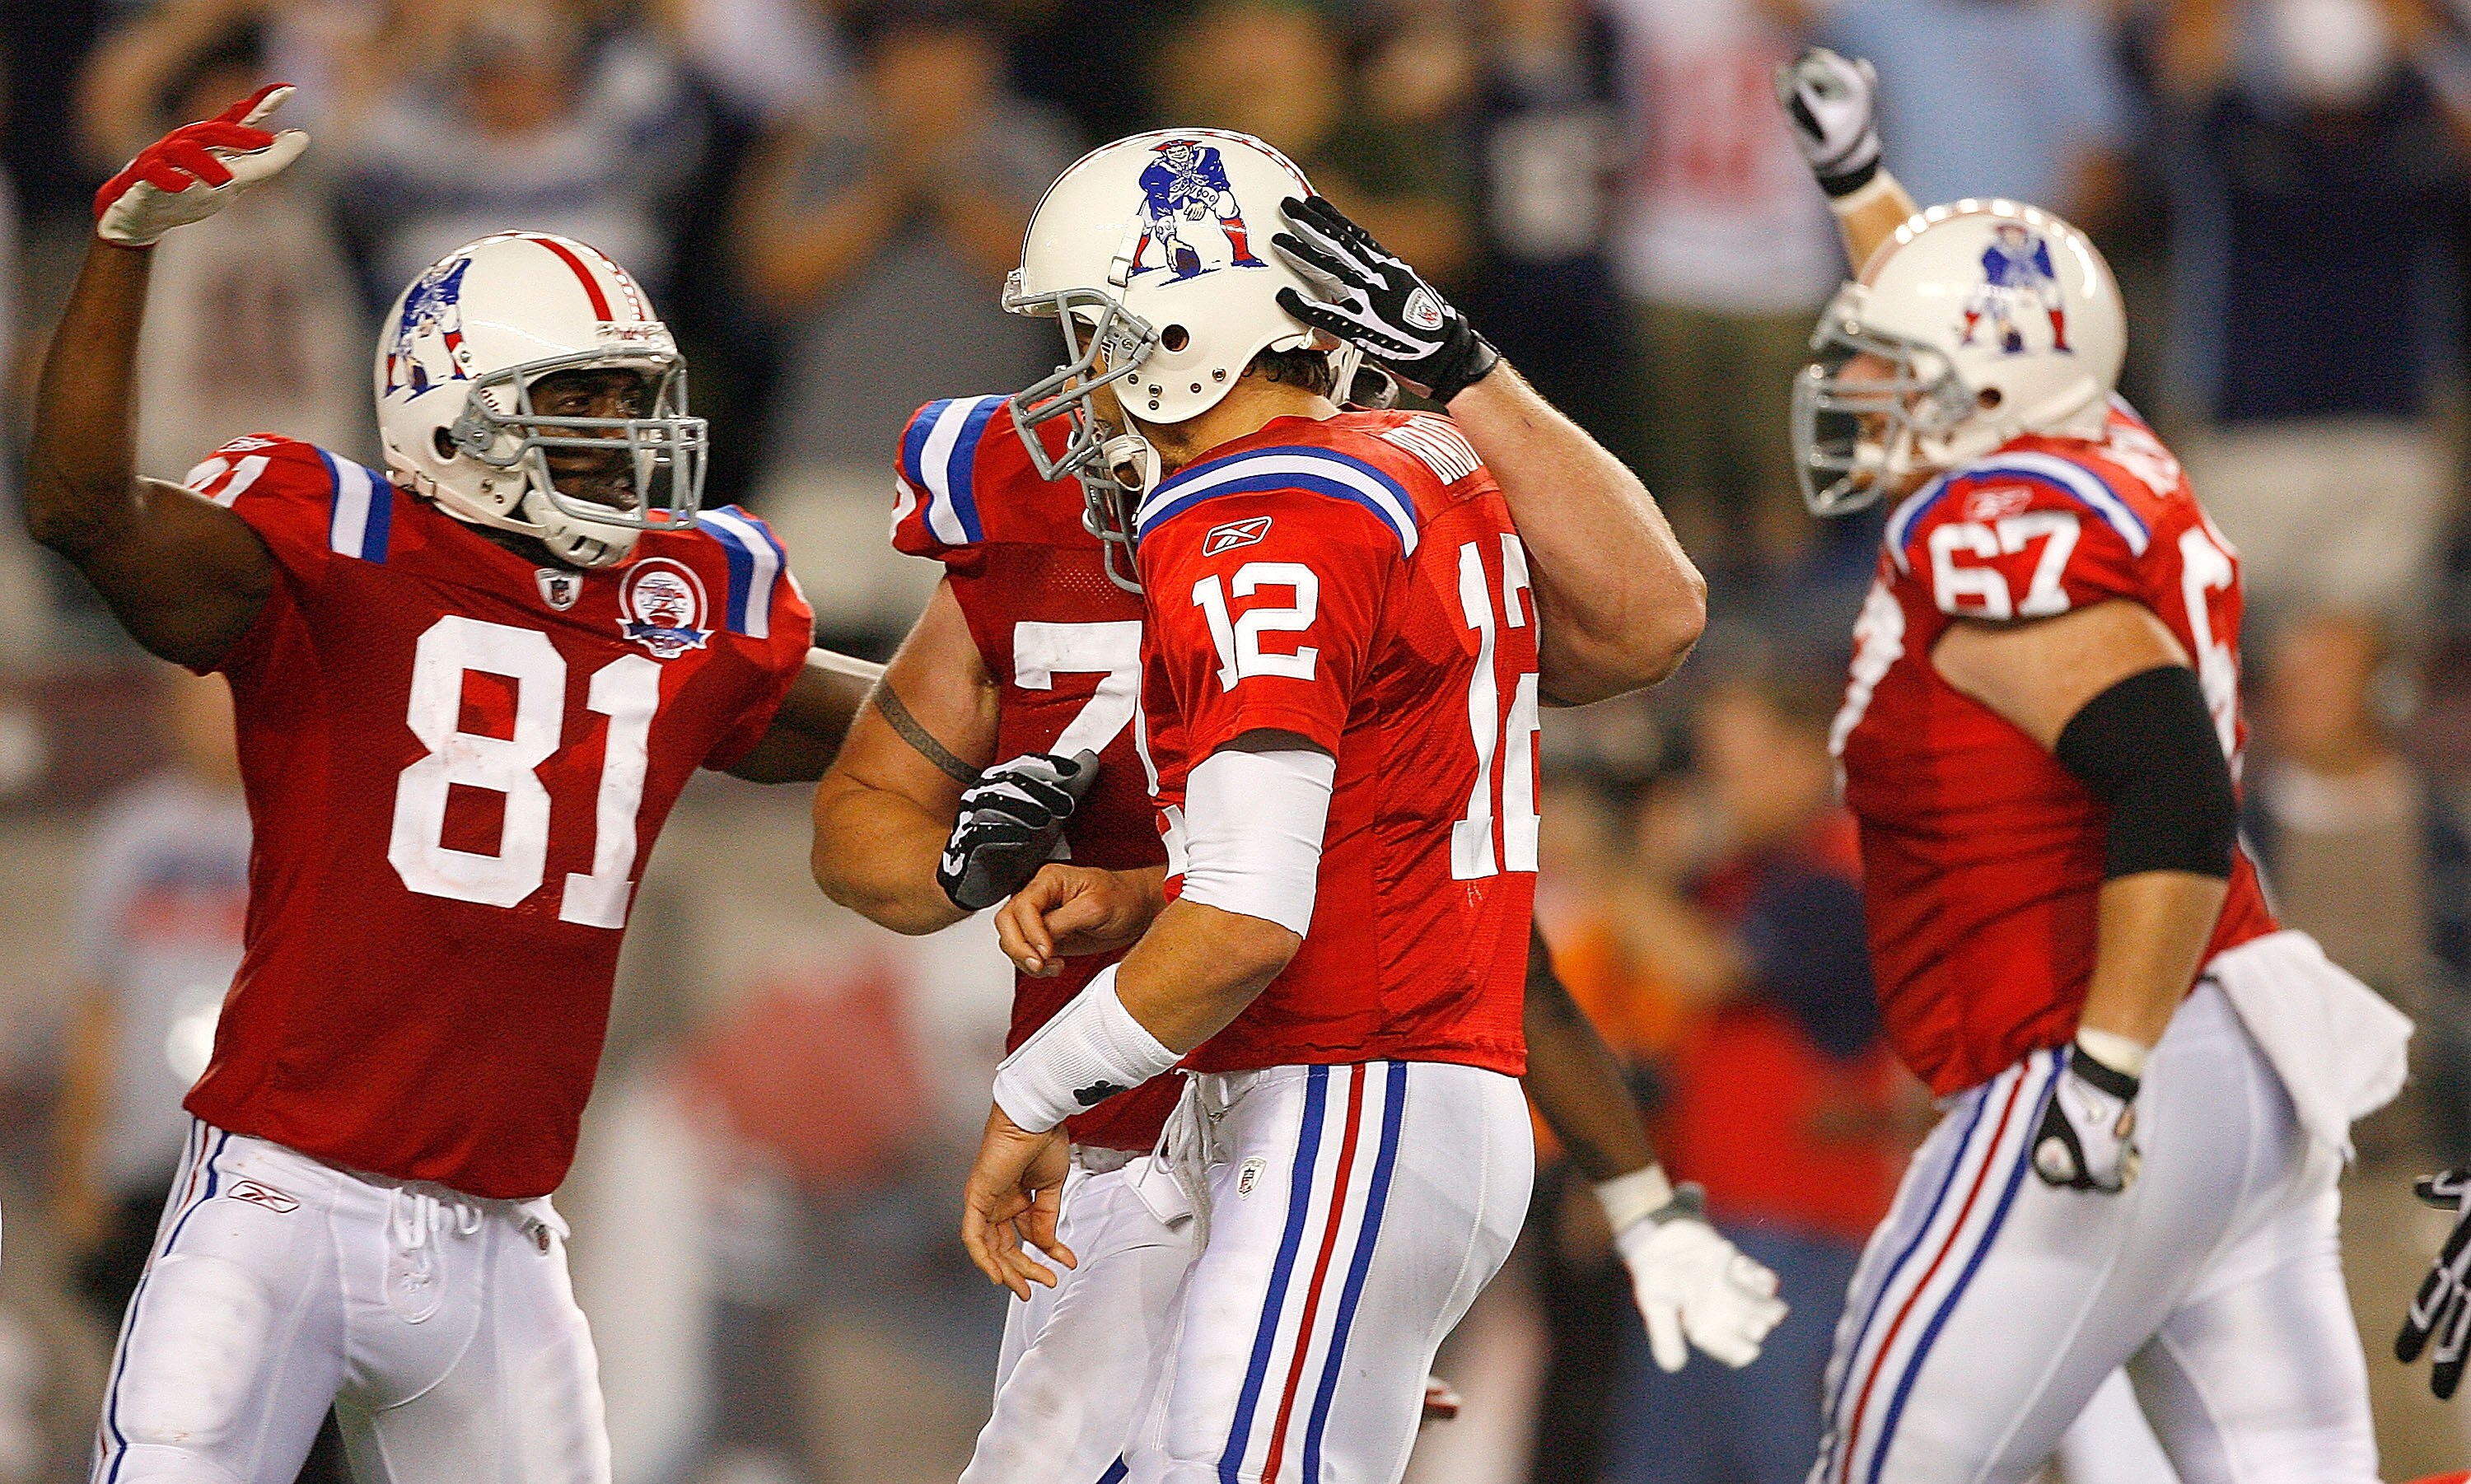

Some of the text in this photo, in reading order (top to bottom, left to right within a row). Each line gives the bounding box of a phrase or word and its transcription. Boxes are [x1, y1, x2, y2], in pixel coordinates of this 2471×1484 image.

[1191, 562, 1320, 693] 12
[1928, 509, 2081, 621] 67
[387, 614, 663, 929] 81
